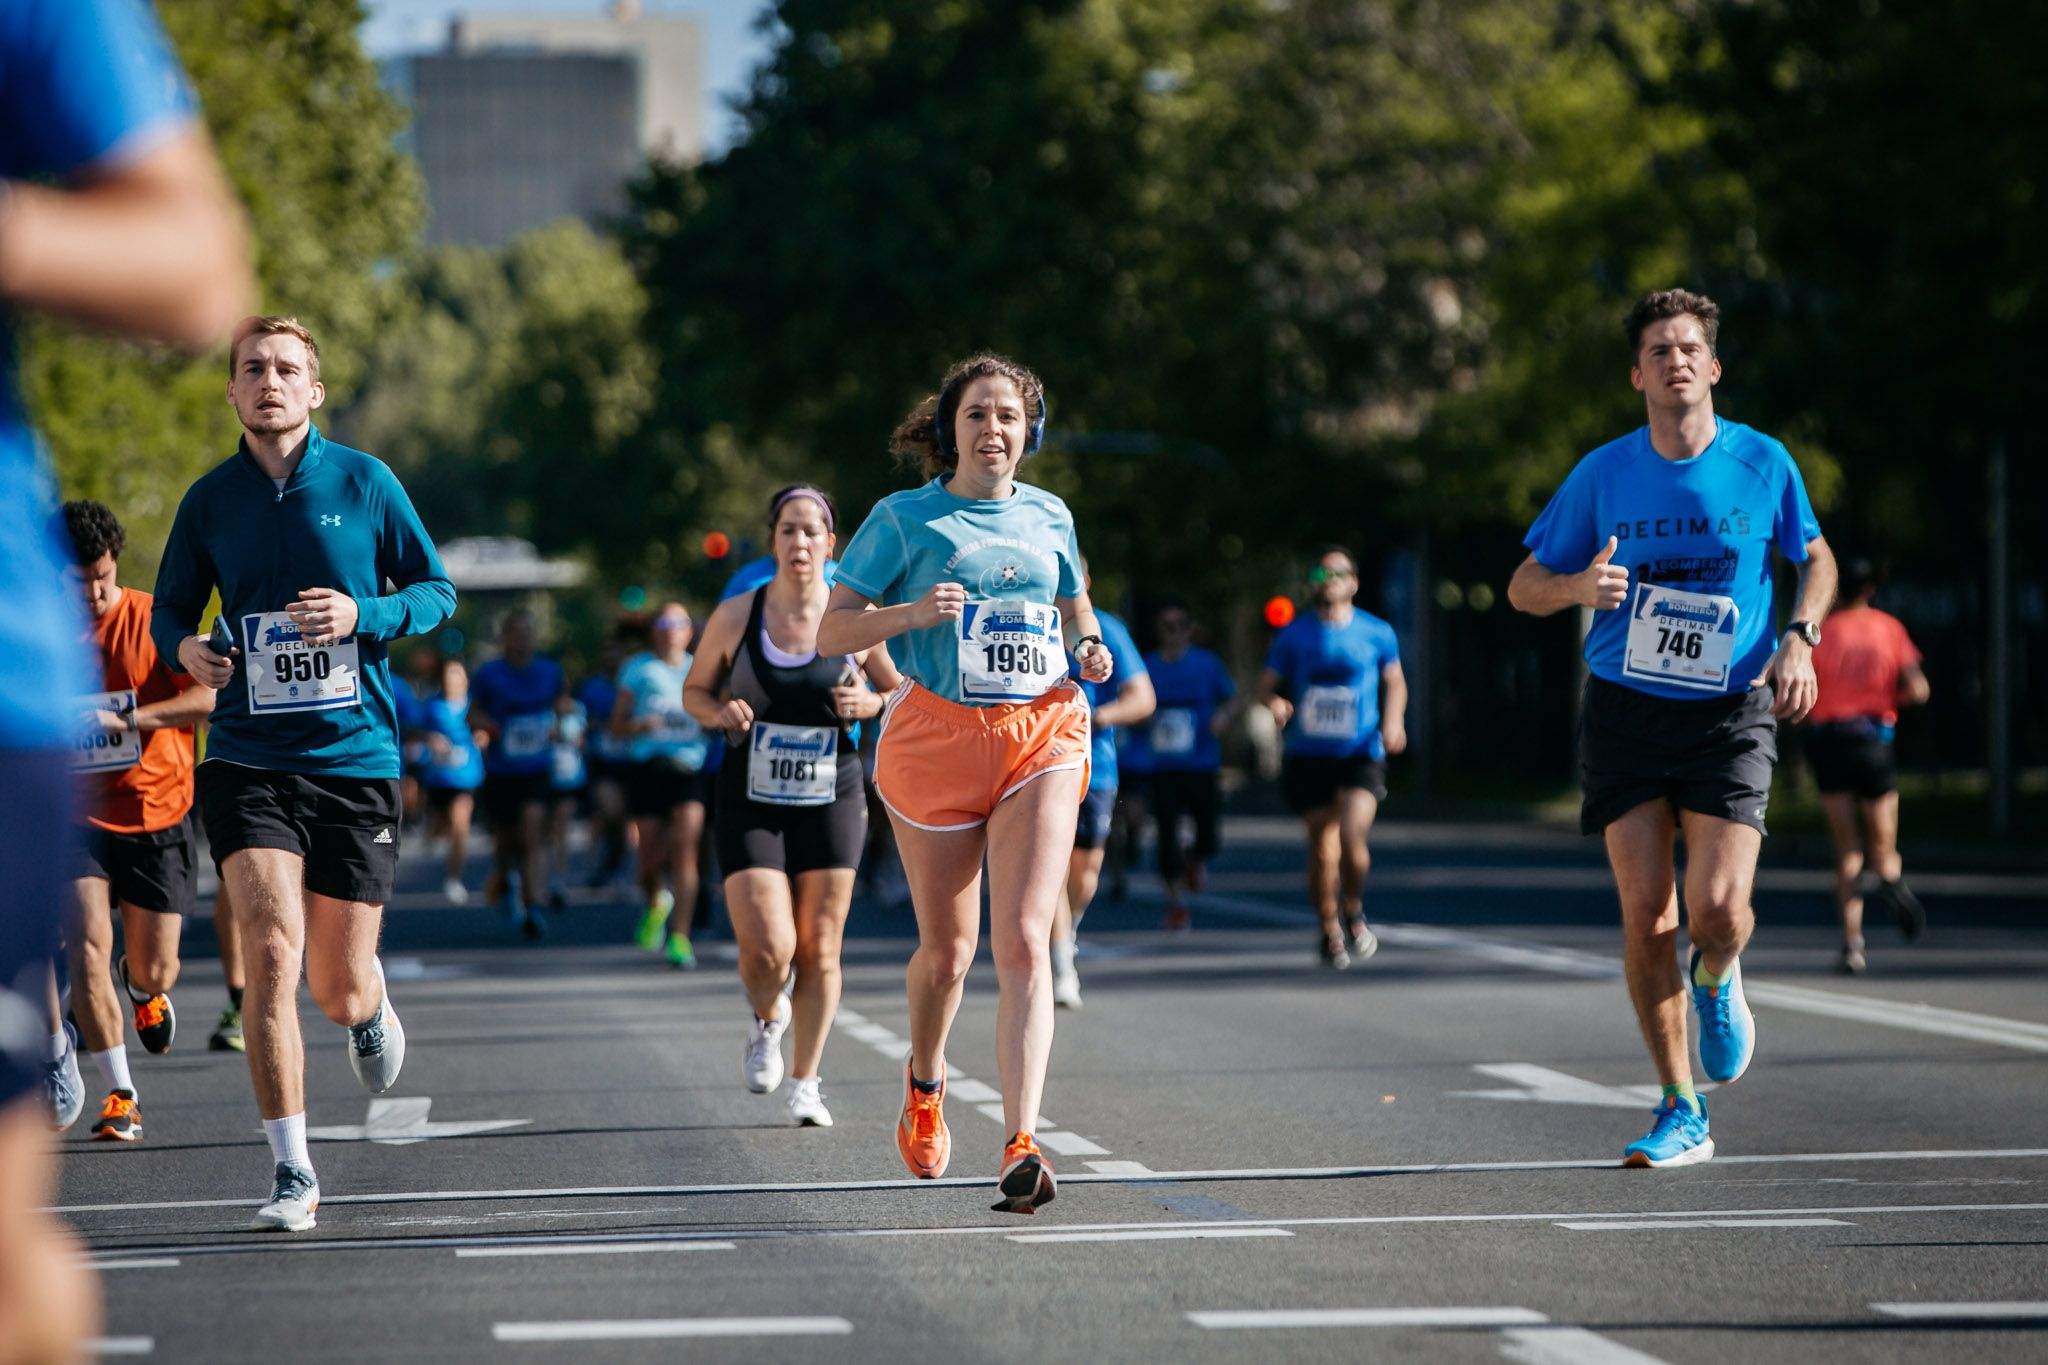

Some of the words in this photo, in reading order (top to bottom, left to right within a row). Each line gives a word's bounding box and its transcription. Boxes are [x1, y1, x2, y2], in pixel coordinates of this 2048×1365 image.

[1617, 516, 1750, 540] DECIMAS
[1659, 558, 1736, 570] BOMBEROS
[999, 615, 1045, 628] BOMOS
[1659, 616, 1715, 632] DECIMAS
[276, 640, 335, 652] DECIMAS
[1656, 627, 1705, 660] 746
[274, 650, 331, 684] 950
[982, 642, 1048, 676] 1930
[770, 757, 816, 781] 1081
